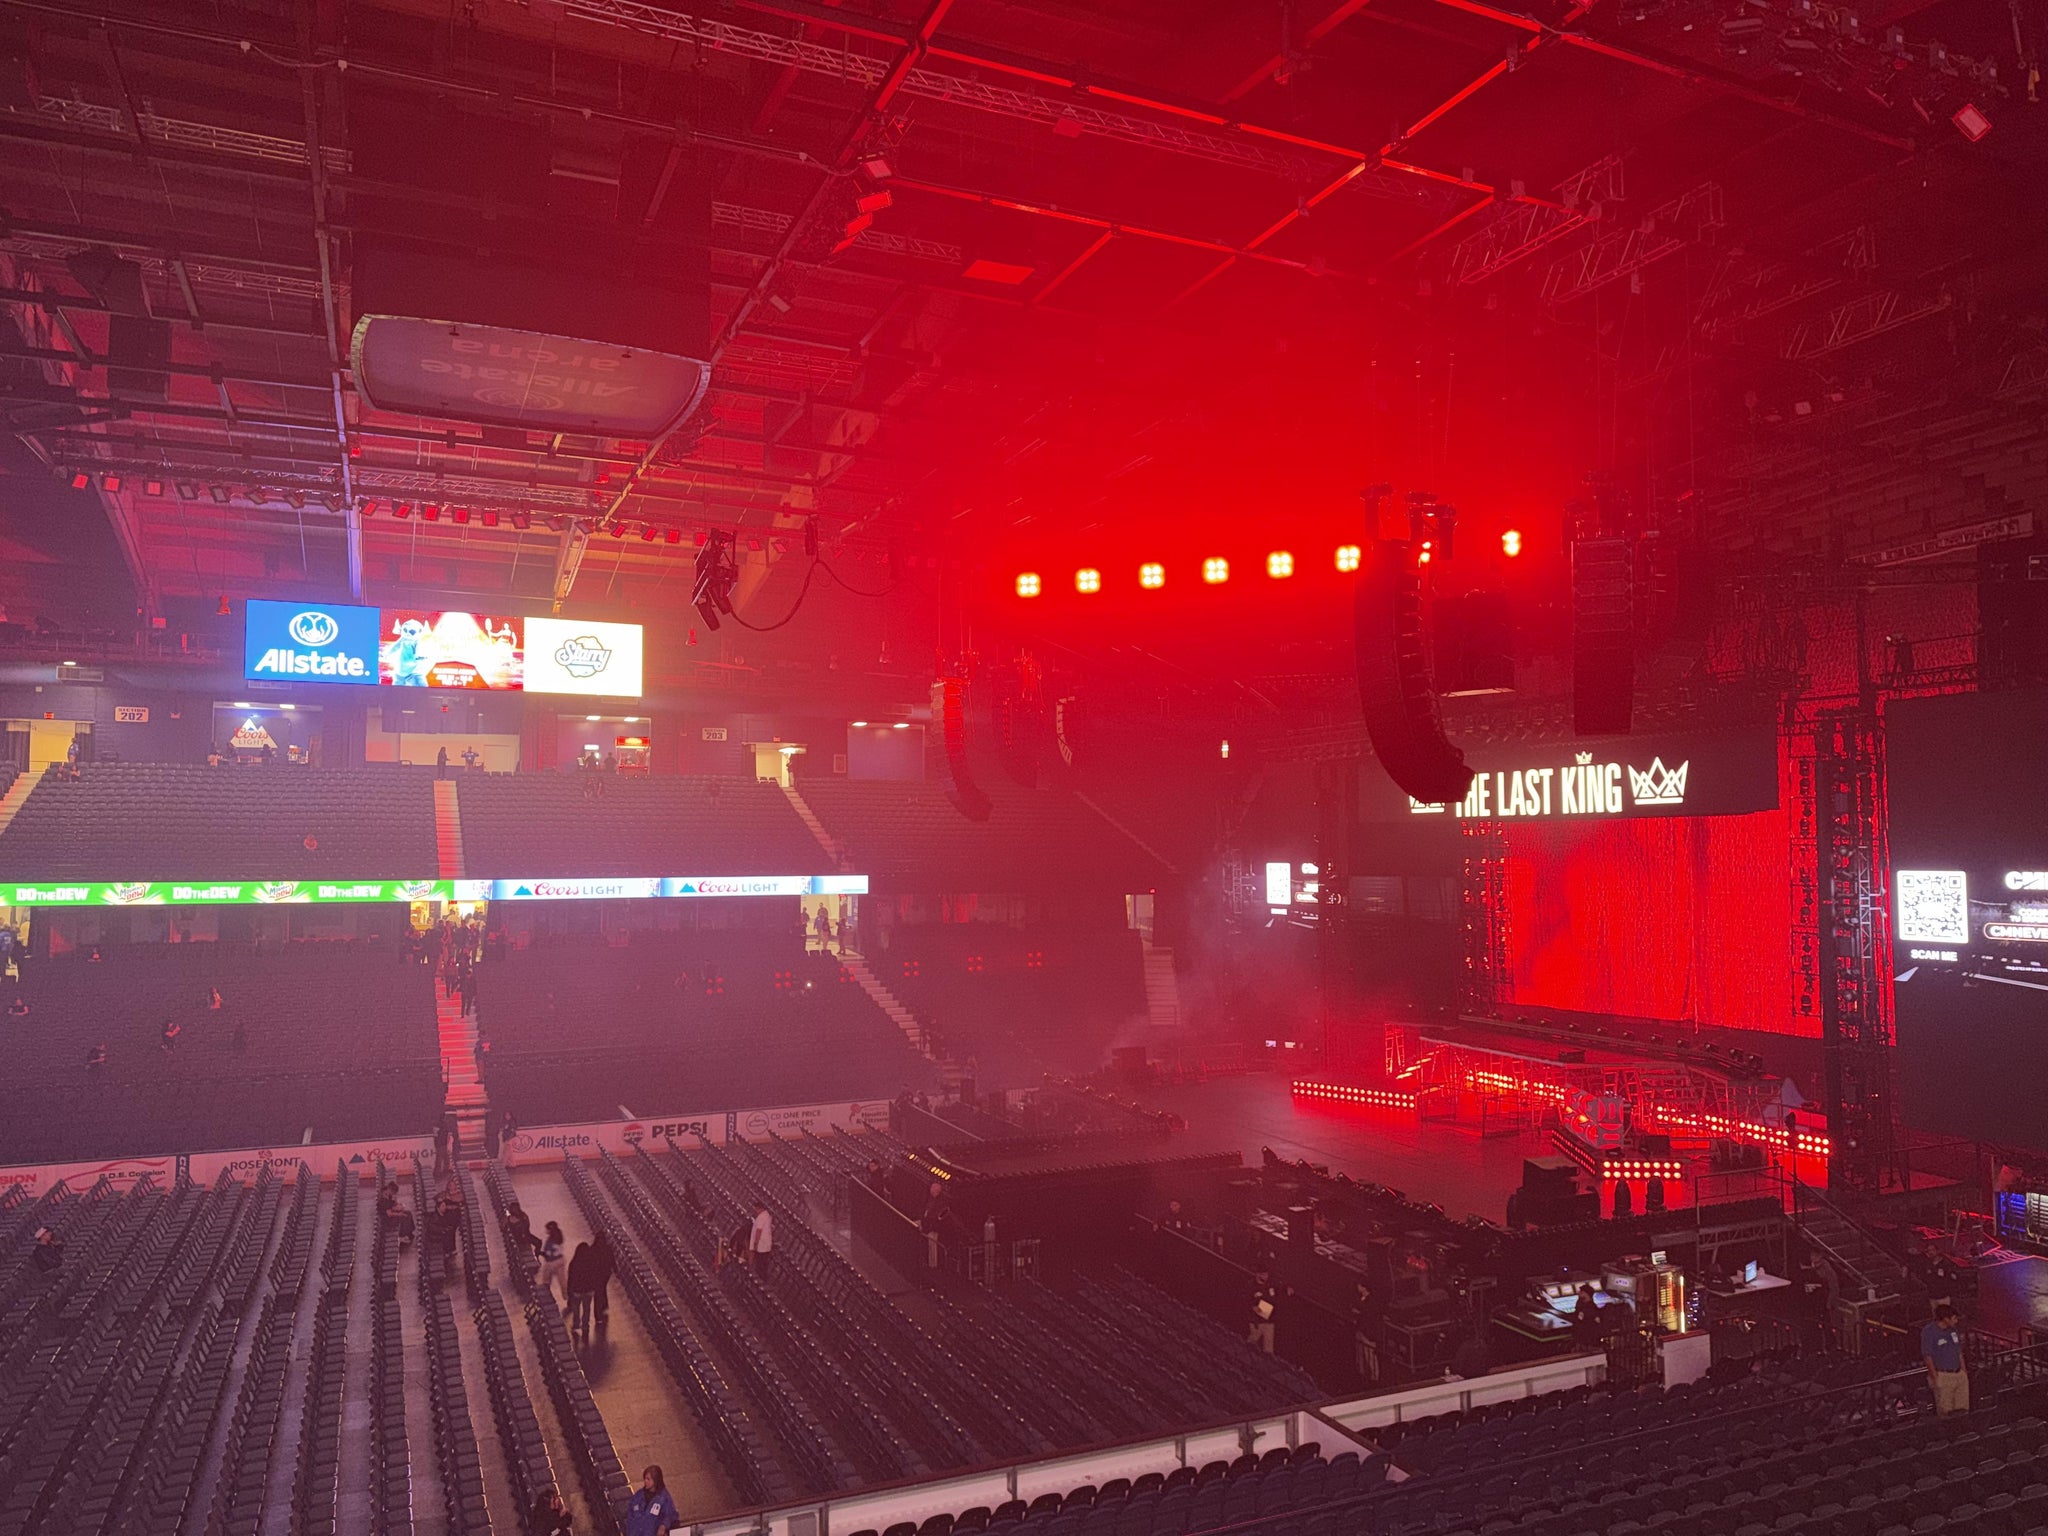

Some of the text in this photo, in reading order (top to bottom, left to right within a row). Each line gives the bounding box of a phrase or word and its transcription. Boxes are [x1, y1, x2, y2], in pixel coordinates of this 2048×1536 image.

[452, 338, 619, 372] arena
[420, 359, 638, 397] Allstate
[121, 712, 143, 721] 202
[233, 727, 269, 739] Coors
[1497, 768, 1553, 817] LAST
[1561, 762, 1623, 815] KING
[534, 882, 624, 896] Coors LIGHT
[698, 880, 779, 893] Coors LIGHT
[1910, 949, 1958, 962] SCAN ME
[784, 1111, 801, 1119] ONE
[652, 1121, 708, 1138] PEPSI
[366, 1148, 408, 1162] Coors
[230, 1156, 301, 1172] ROSEMONT
